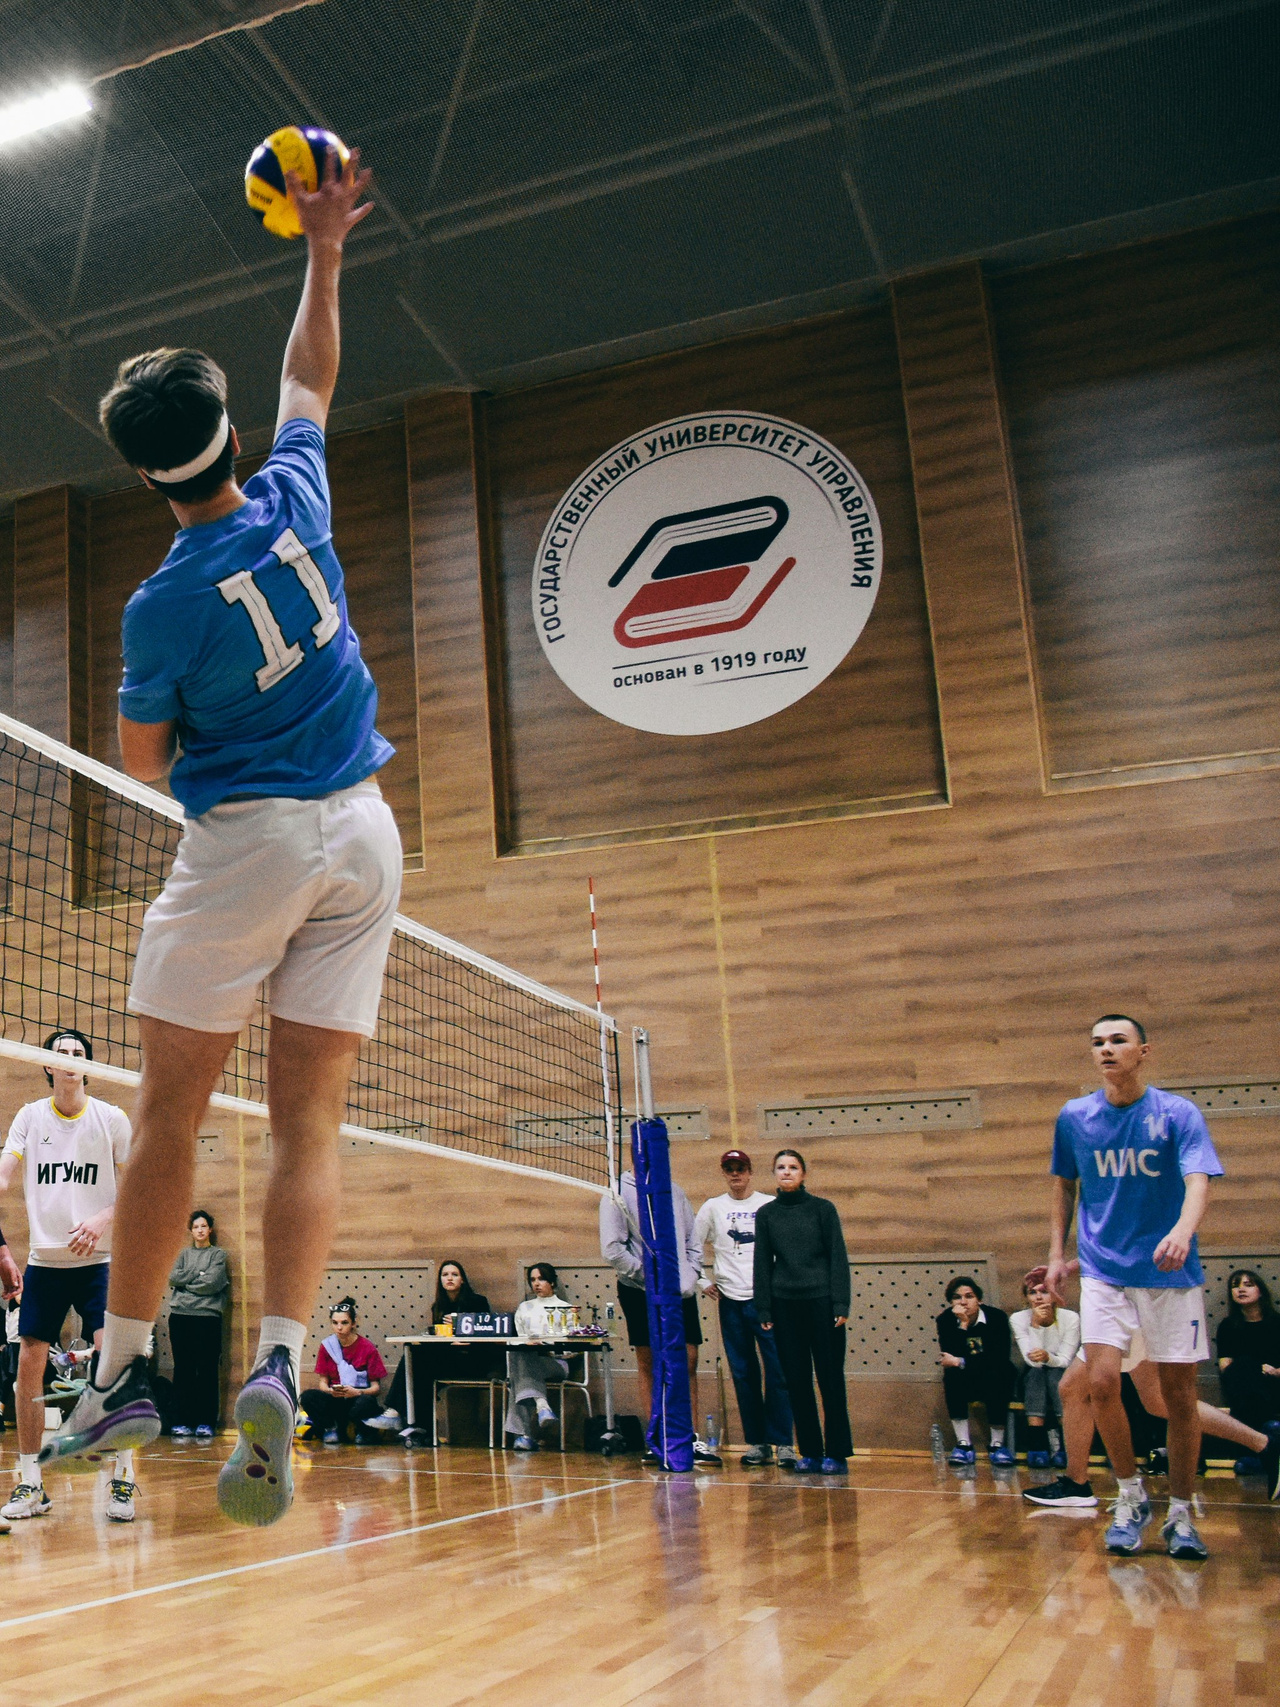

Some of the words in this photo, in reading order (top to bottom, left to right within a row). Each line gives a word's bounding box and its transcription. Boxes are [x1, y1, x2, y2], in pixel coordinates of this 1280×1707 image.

[539, 445, 641, 644] ГОСУДАРСТВЕННЫЙ
[644, 423, 810, 458] УНИВЕРСИТЕТ
[806, 450, 876, 589] УПРАВЛЕНИЯ
[215, 526, 341, 693] 11
[613, 666, 687, 688] основан
[694, 663, 704, 675] в
[710, 651, 757, 672] 1919
[763, 646, 807, 664] году
[37, 1160, 99, 1185] ИГУиП
[461, 1316, 473, 1334] 6
[494, 1316, 509, 1334] 11
